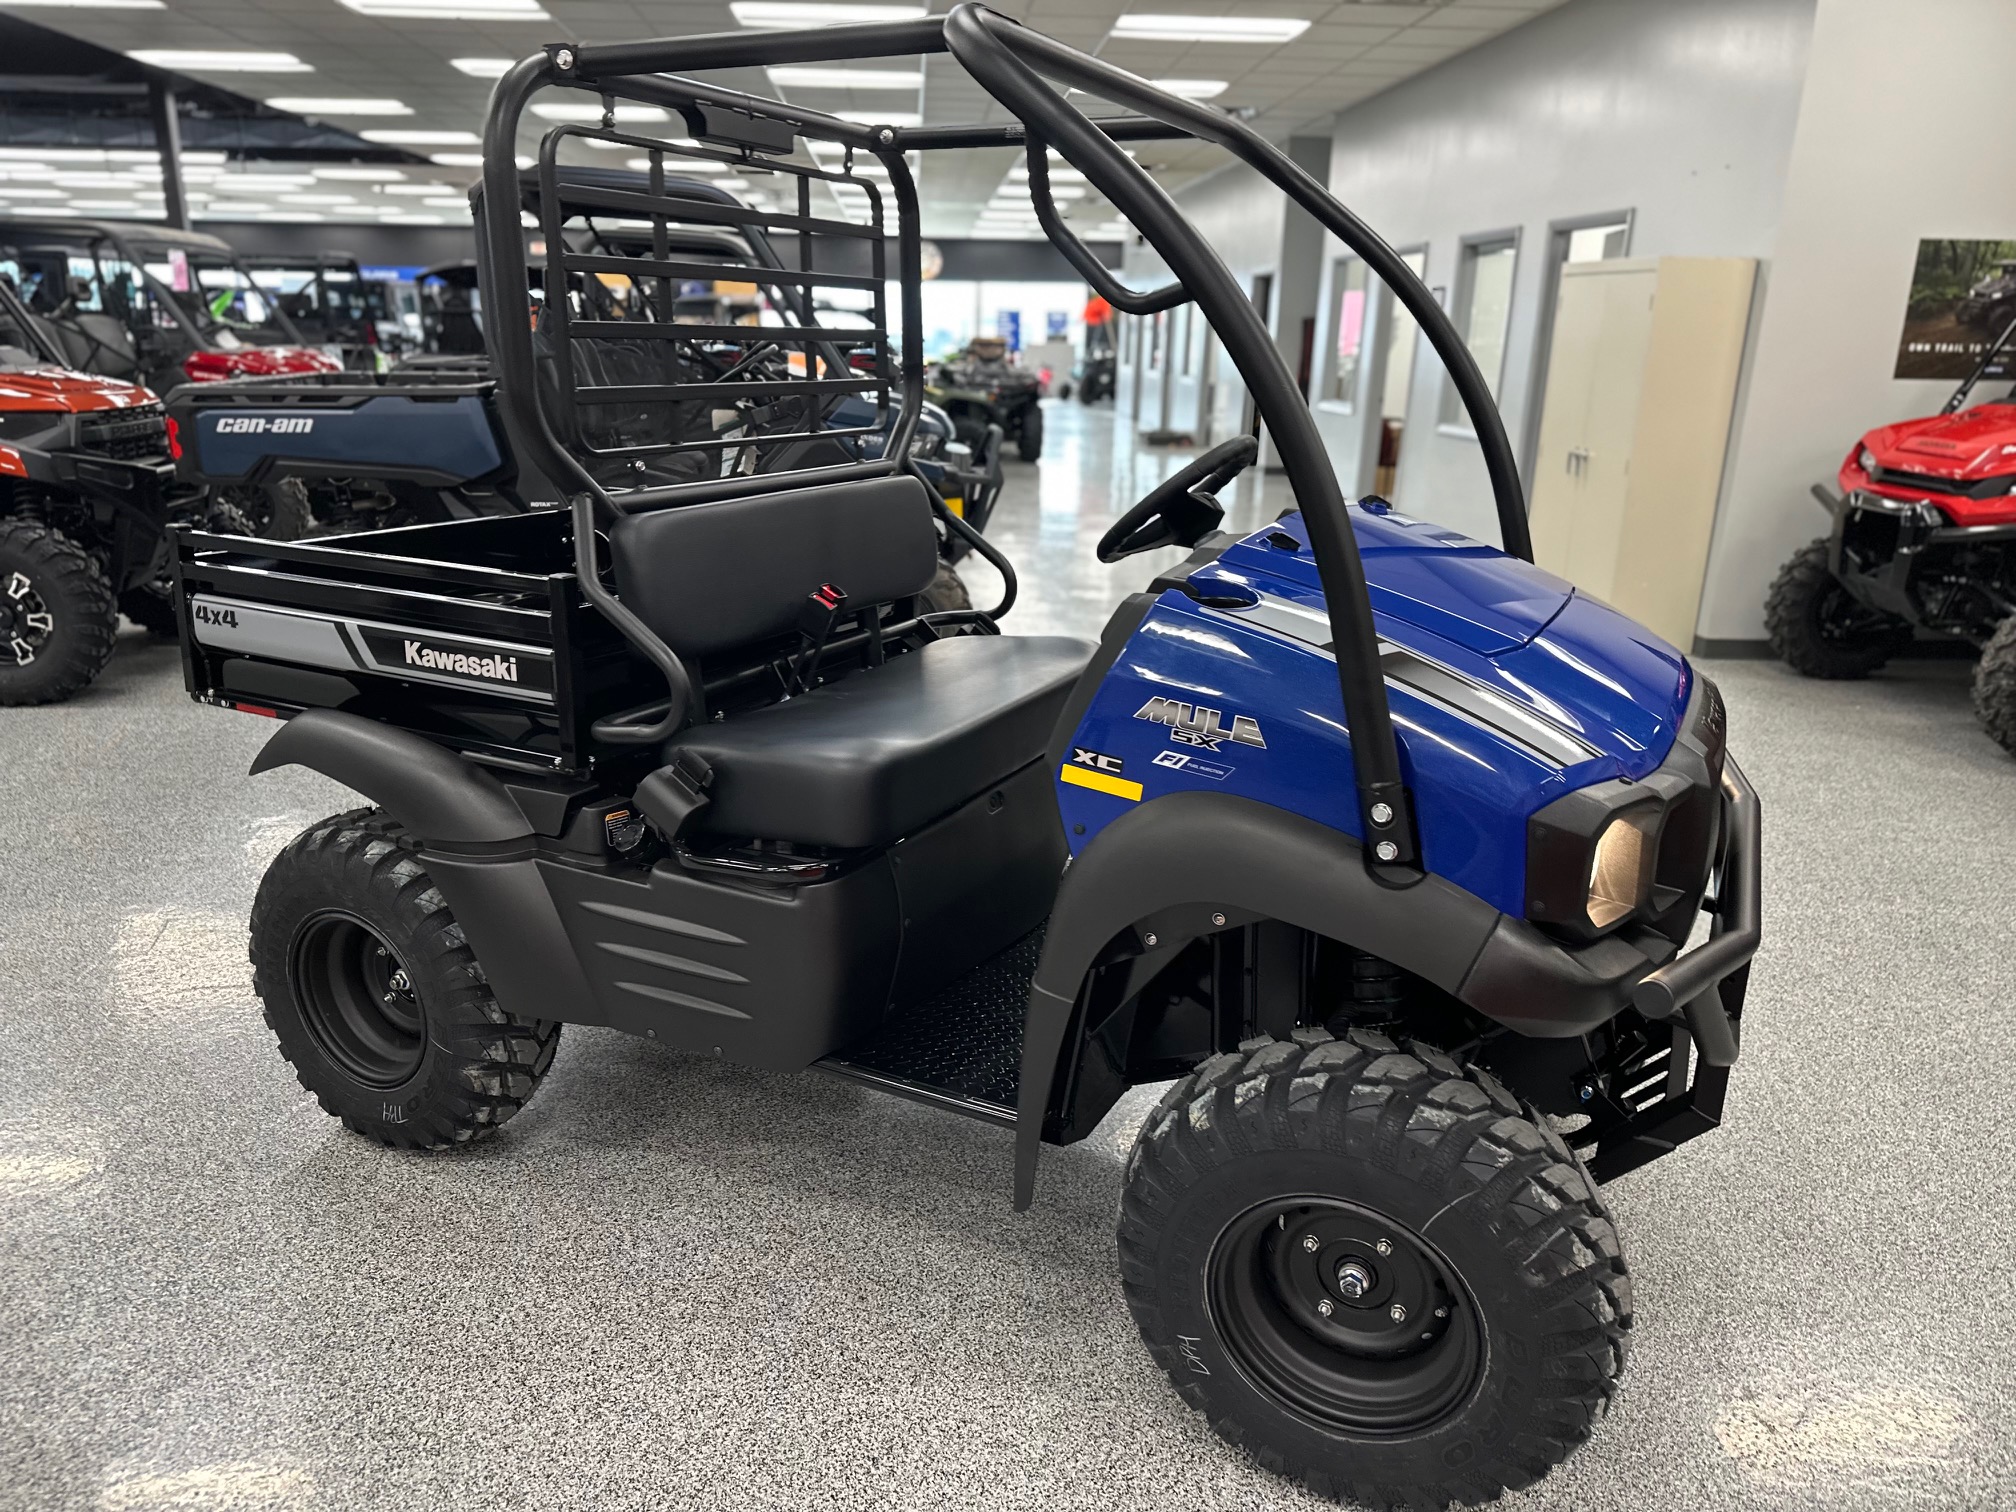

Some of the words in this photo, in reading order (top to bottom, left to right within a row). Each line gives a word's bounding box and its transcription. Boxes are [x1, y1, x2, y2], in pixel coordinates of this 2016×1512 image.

[1935, 342, 1964, 353] TRAIL
[1969, 342, 1982, 353] TO
[216, 417, 314, 434] can-am
[194, 604, 239, 629] 4x4
[403, 639, 519, 682] Kawasaki
[1133, 695, 1267, 750] MULE
[1169, 728, 1222, 753] SX
[1073, 747, 1123, 774] XC
[1156, 752, 1186, 767] FI
[1441, 1330, 1528, 1469] DURO
